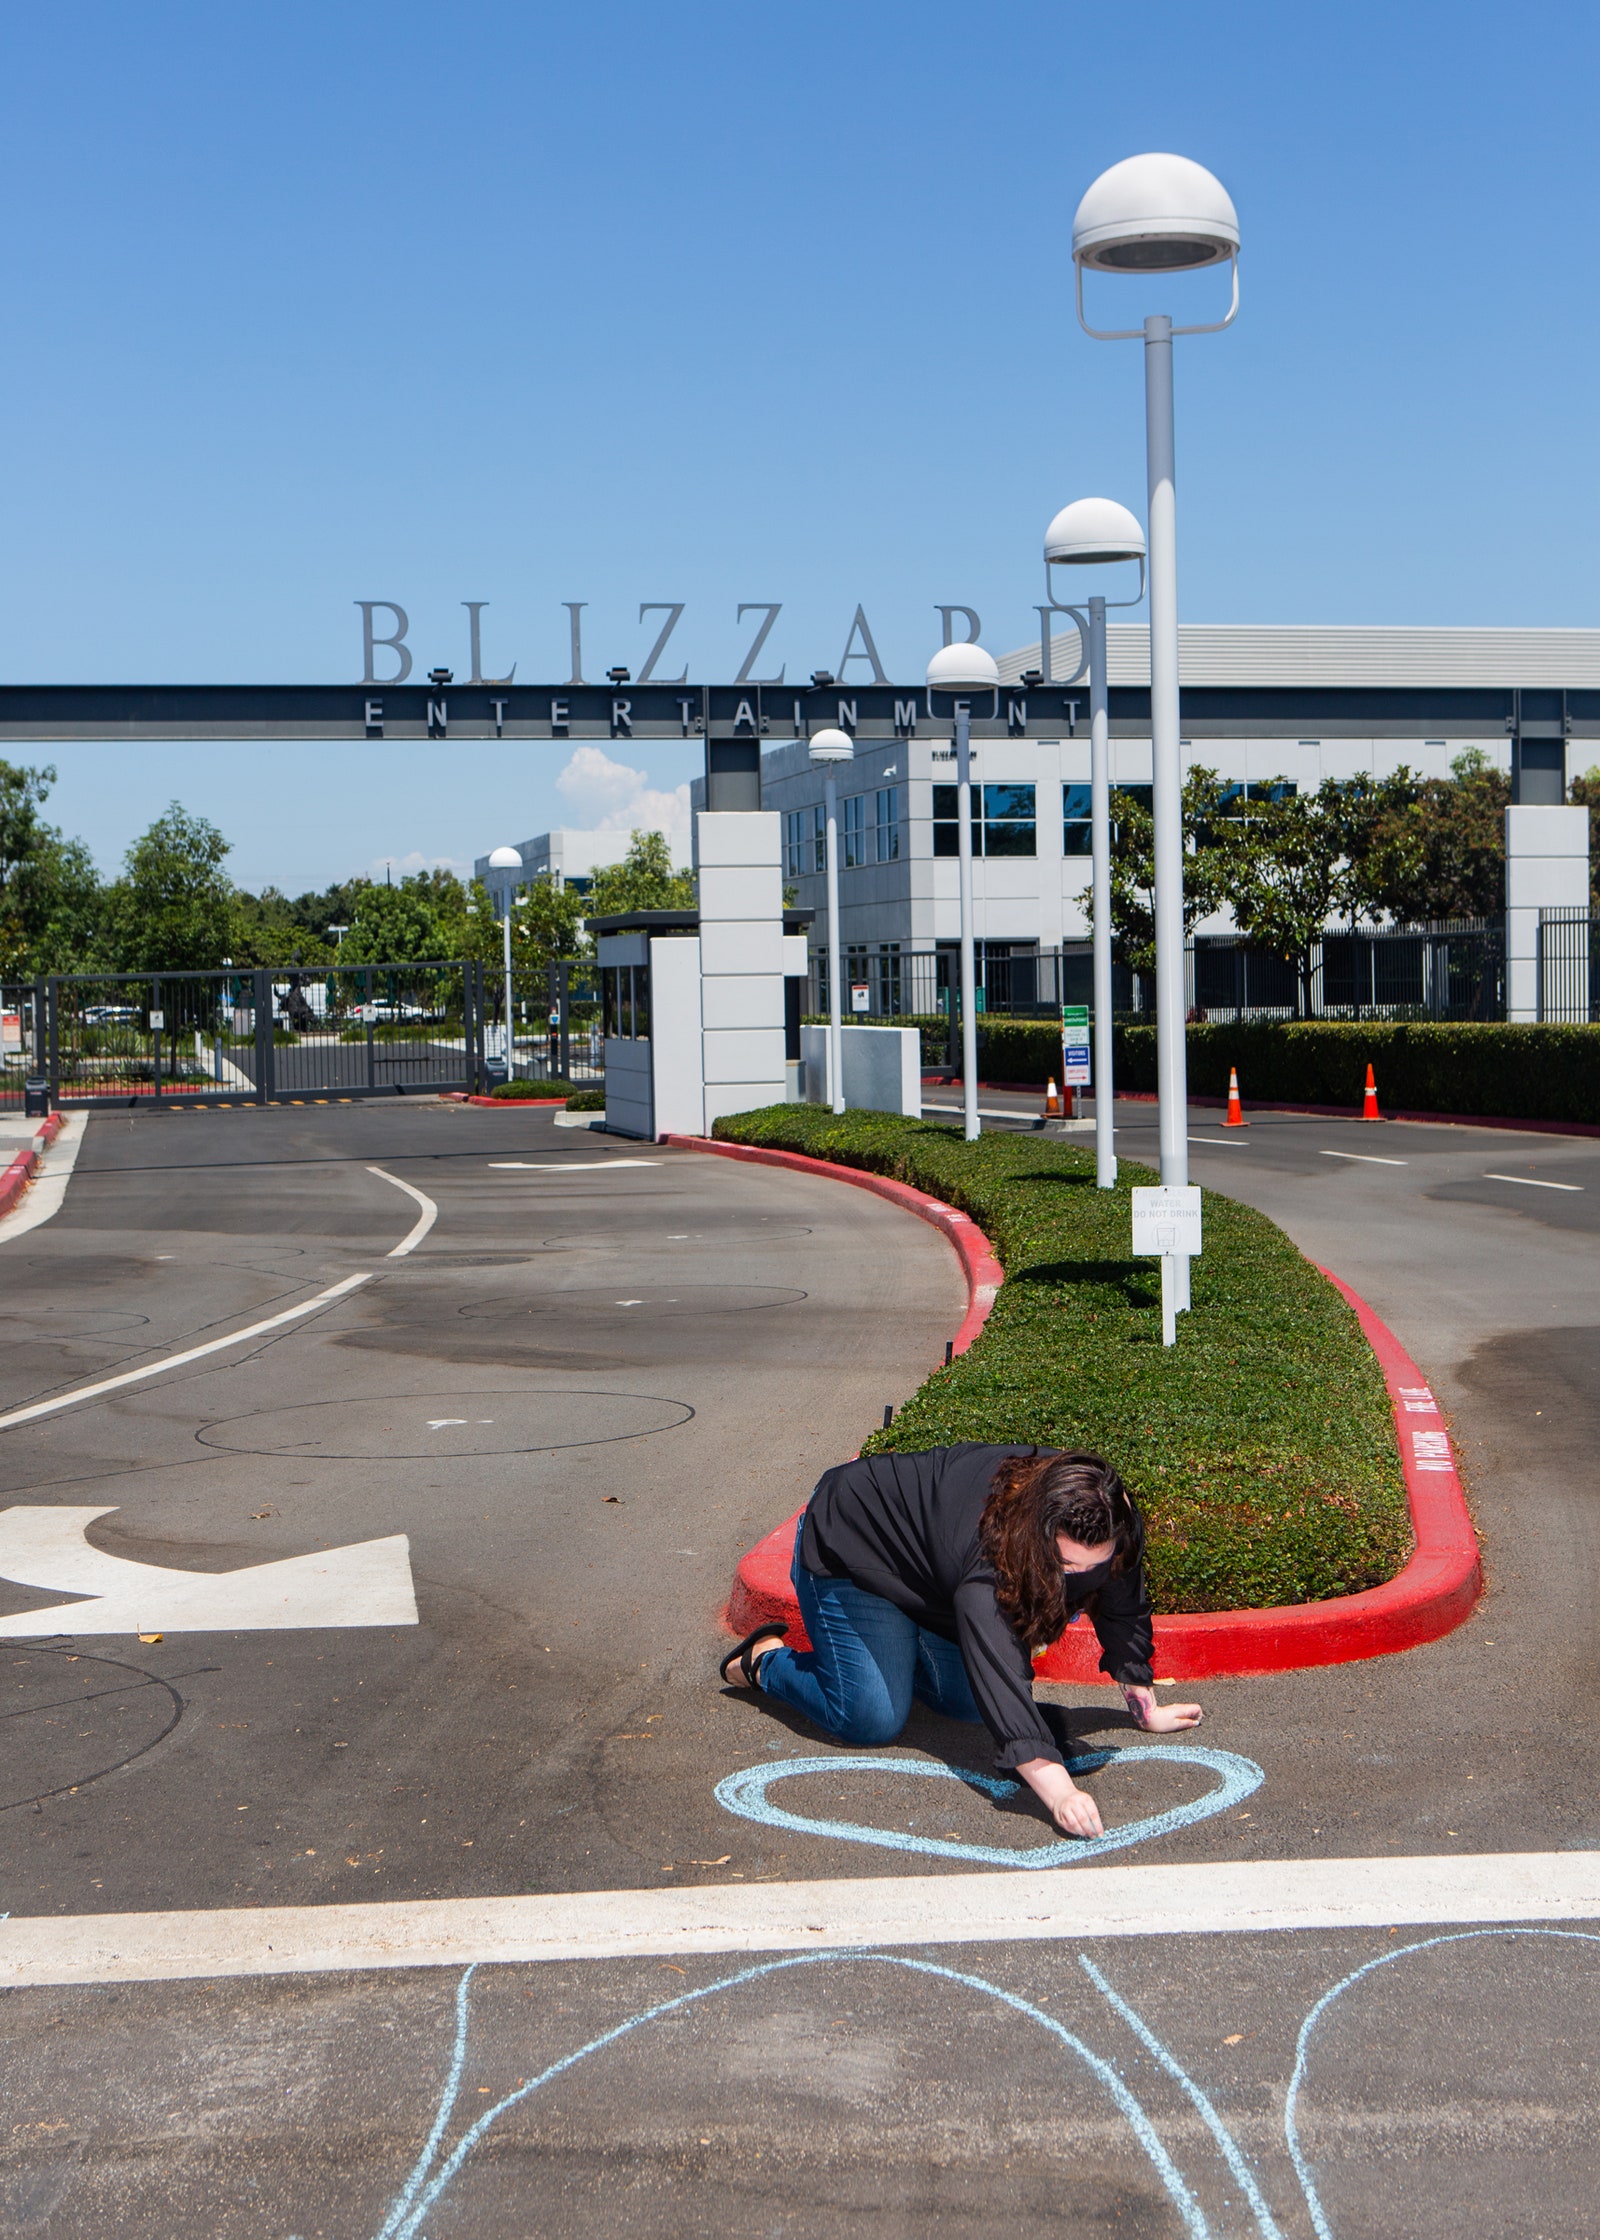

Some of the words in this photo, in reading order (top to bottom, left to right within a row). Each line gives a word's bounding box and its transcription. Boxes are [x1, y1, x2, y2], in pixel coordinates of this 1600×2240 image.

[364, 698, 1081, 727] ENTERTAINMENT
[1150, 1199, 1181, 1208] WATER
[1134, 1210, 1146, 1218] DO
[1149, 1210, 1167, 1218] NOT
[1170, 1209, 1199, 1218] DRINK
[1412, 1431, 1451, 1458] PARKING
[1416, 1460, 1454, 1472] NO
